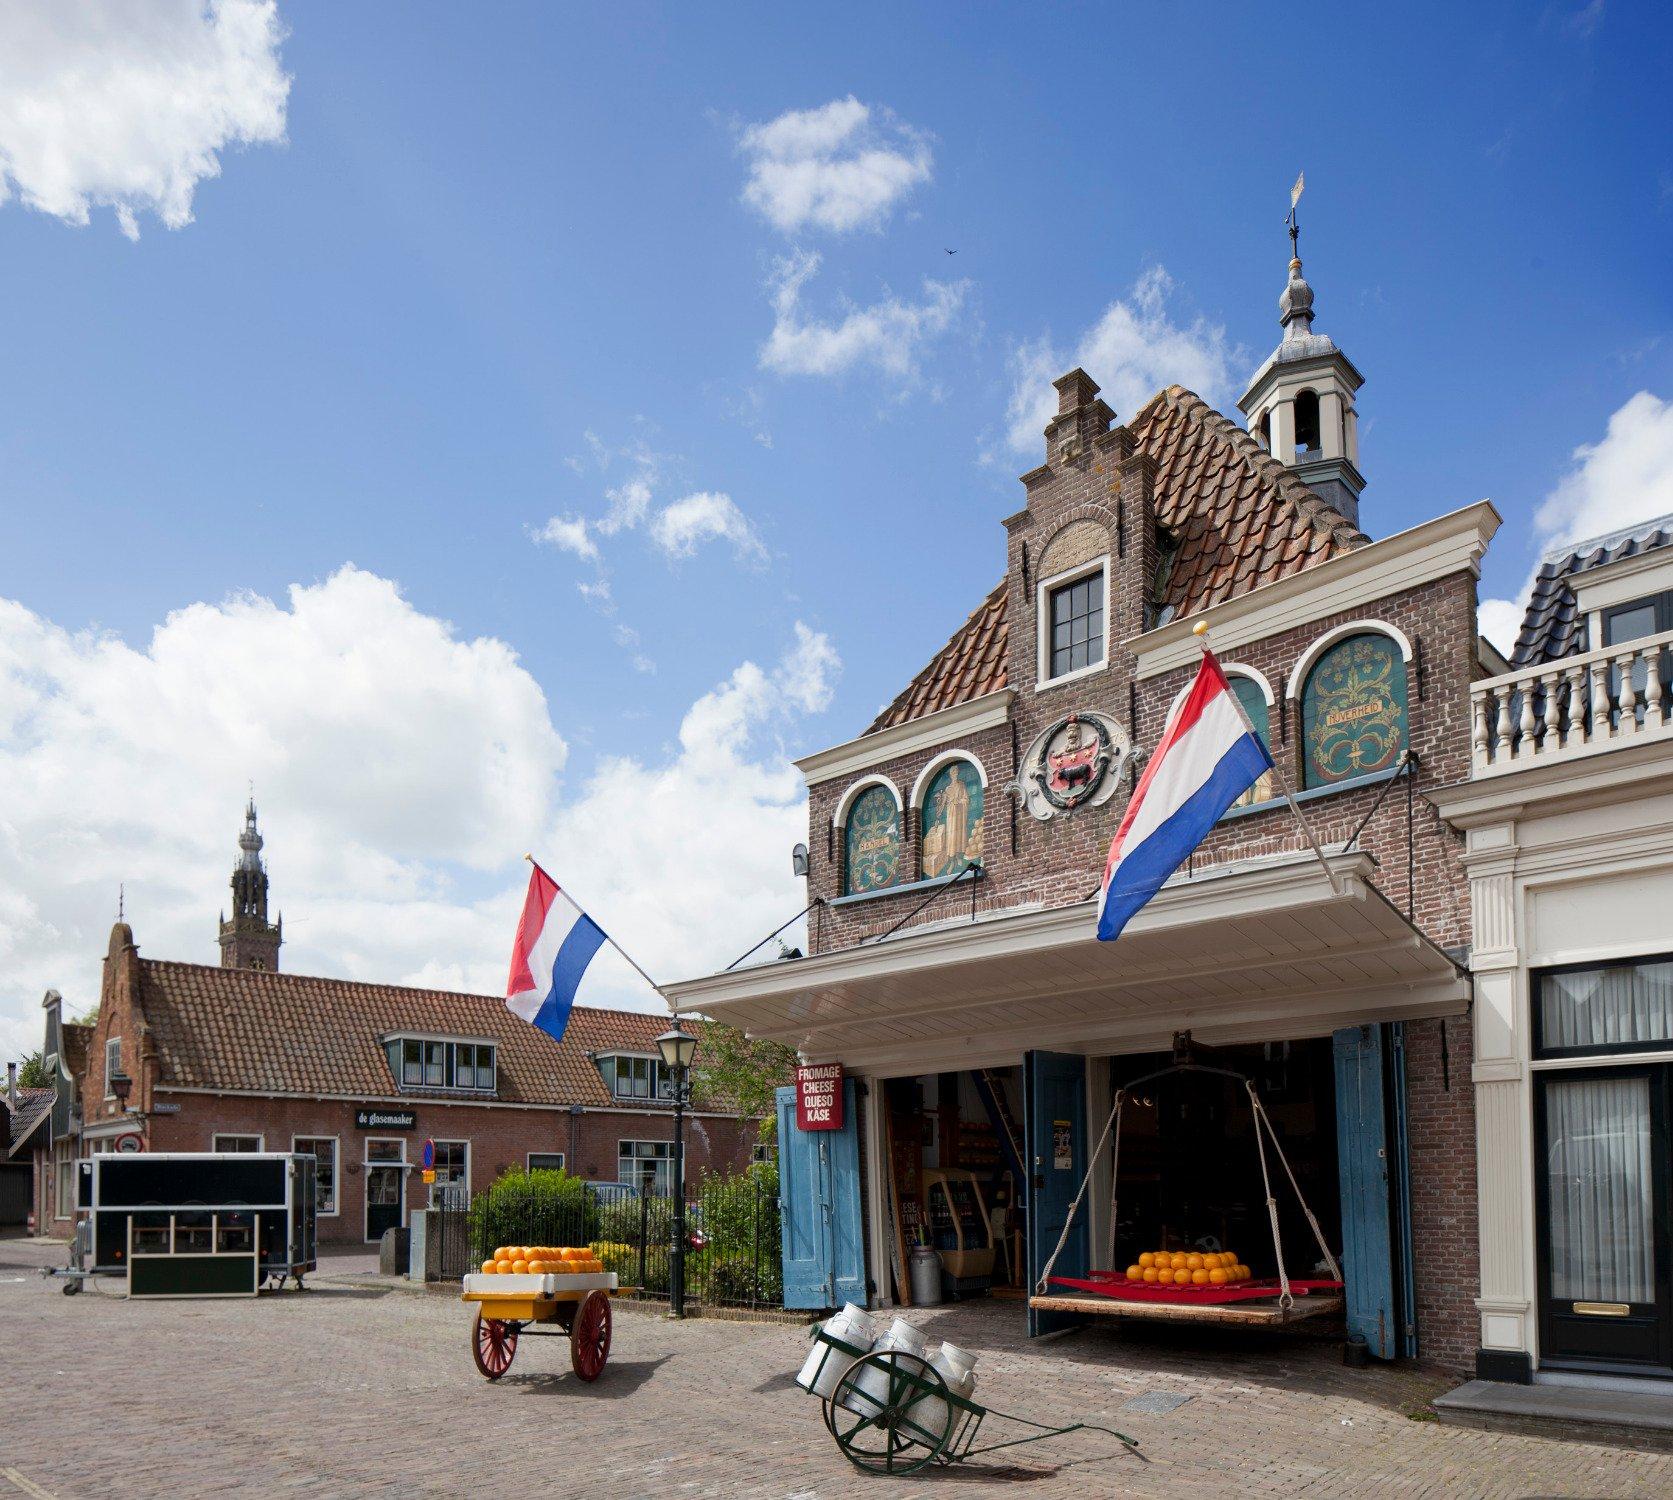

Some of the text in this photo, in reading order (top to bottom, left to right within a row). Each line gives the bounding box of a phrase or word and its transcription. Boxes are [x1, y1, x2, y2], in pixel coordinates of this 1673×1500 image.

[798, 1066, 840, 1080] FROMAGE
[803, 1080, 835, 1094] CHEESE
[804, 1094, 833, 1108] QUESO
[359, 1112, 413, 1126] de glasemaaker
[807, 1107, 830, 1121] KÄSE
